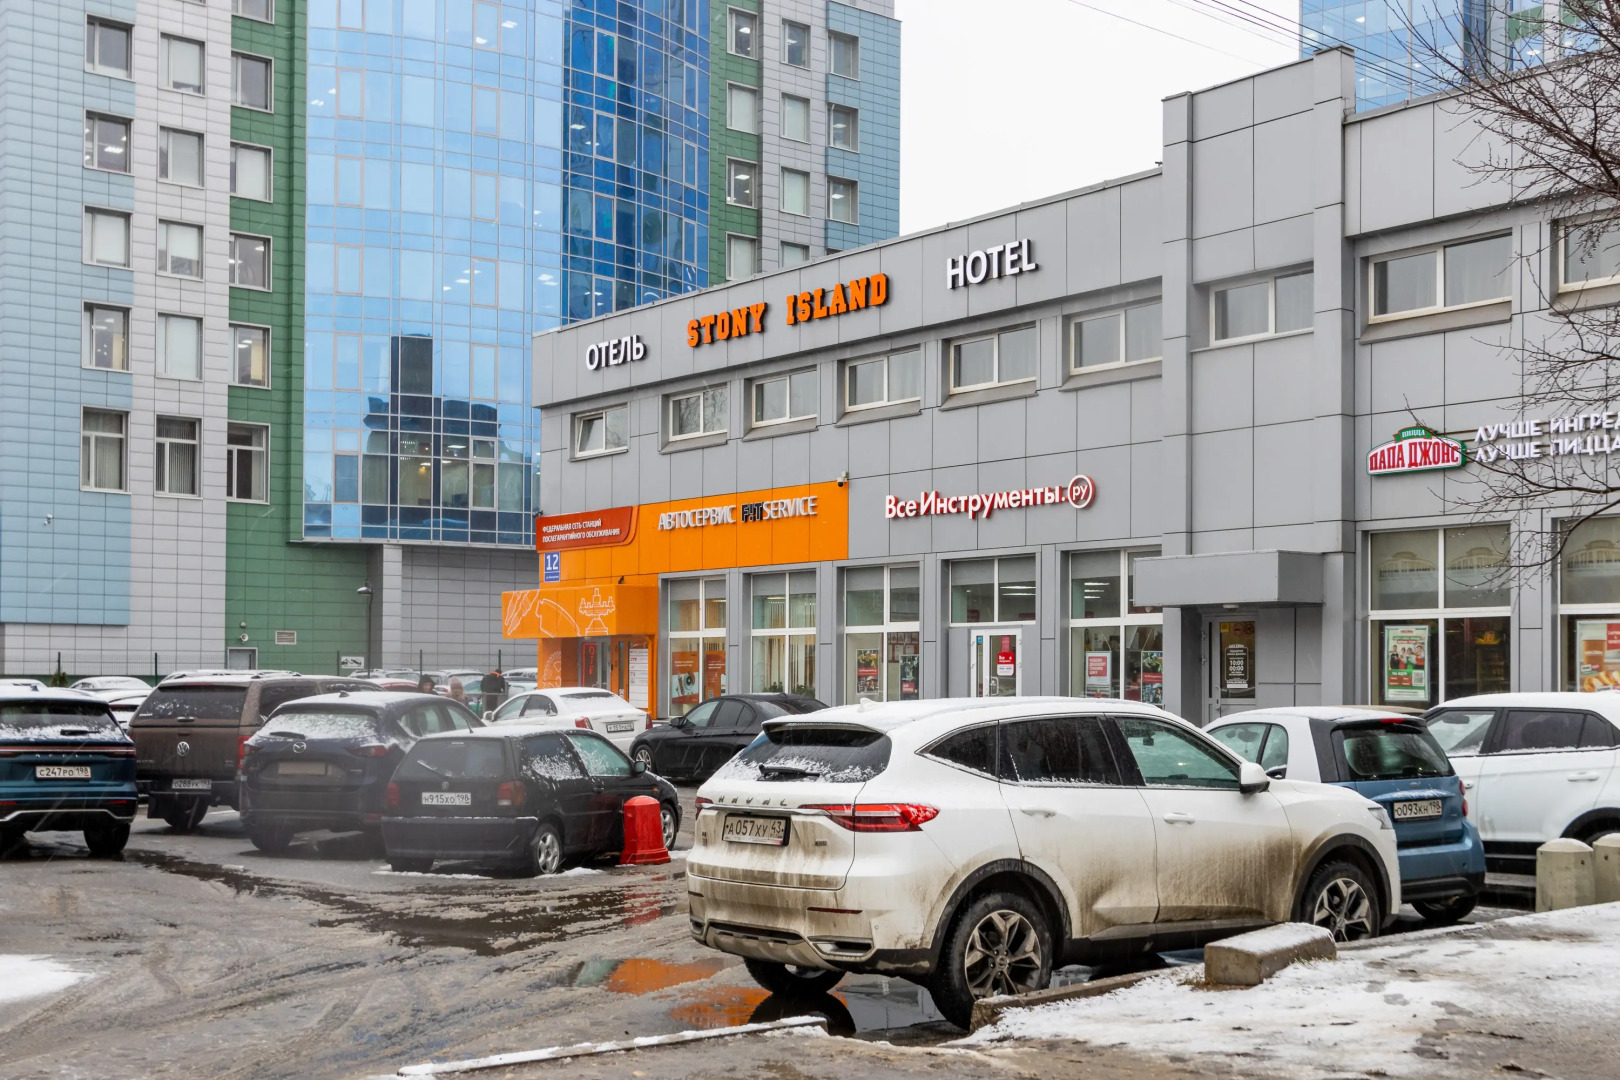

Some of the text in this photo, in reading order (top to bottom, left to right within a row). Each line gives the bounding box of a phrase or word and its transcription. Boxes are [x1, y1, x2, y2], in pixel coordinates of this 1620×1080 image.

[946, 238, 1036, 289] HOTEL
[687, 273, 888, 348] STONY ISLAND
[585, 334, 647, 371] ОТЕЛЬ
[1401, 429, 1426, 438] ПИЦЦА
[1474, 420, 1543, 442] ЛУЧШЕ
[1369, 441, 1459, 471] ПАПА ДЖОНС
[1474, 441, 1542, 463] ЛУЧШЕ
[542, 518, 602, 533] ФЕДЕРАЛЬНАЯ СЕТЬ СТАНЦИЙ
[658, 504, 737, 531] АВТОСЕРВИС
[546, 553, 559, 571] 12
